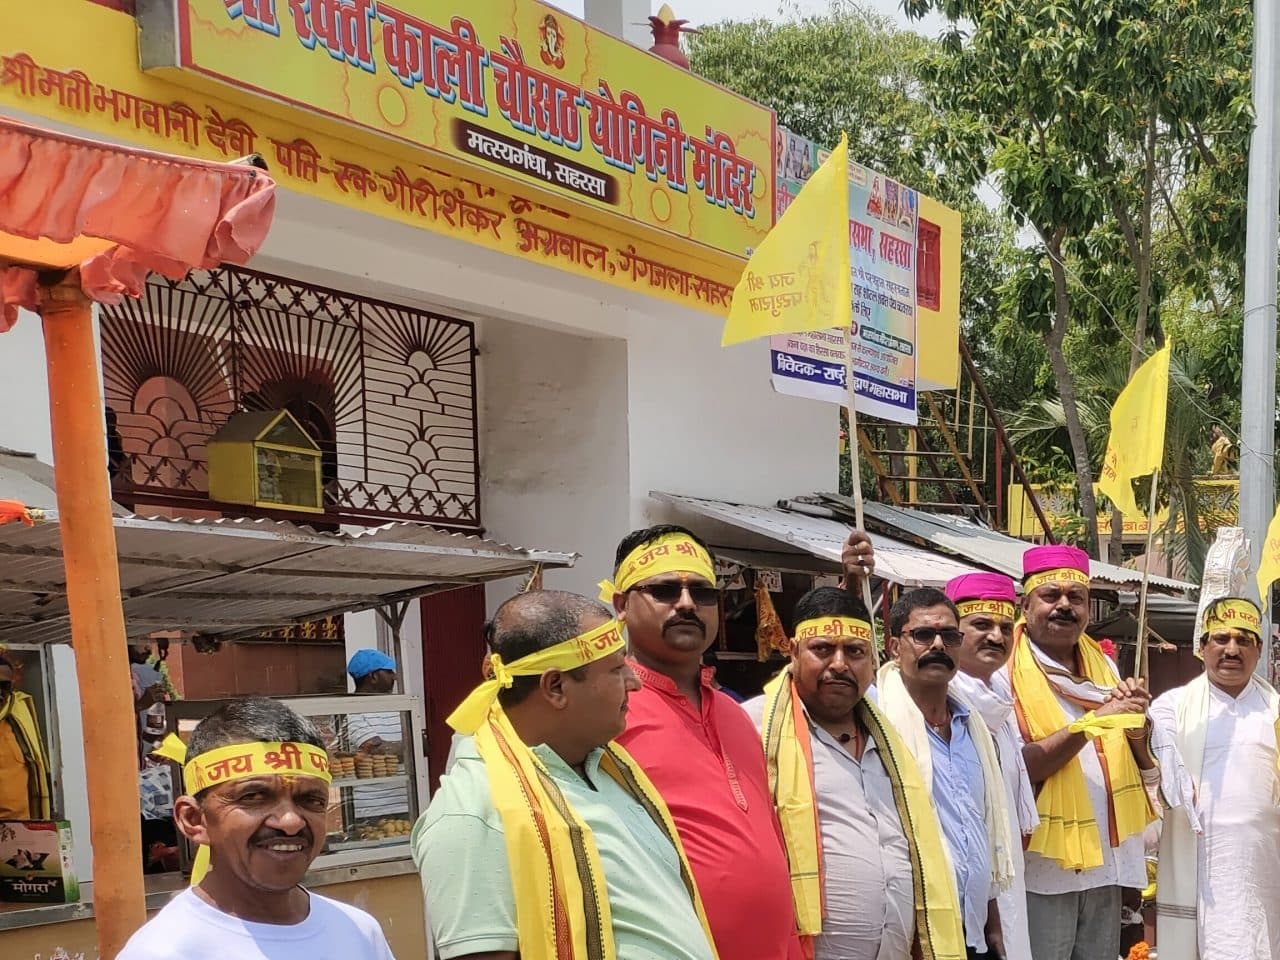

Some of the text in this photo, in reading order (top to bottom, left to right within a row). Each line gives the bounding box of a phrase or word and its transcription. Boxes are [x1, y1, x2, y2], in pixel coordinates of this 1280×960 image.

[376, 2, 489, 117] काली
[491, 36, 586, 151] चौसठ
[584, 78, 690, 194] योगिनी
[688, 125, 757, 219] मंदिर
[467, 128, 606, 198] मत्स्यगंधा, सहरसा
[879, 231, 913, 272] सहरसा
[690, 274, 734, 309] सहर
[637, 541, 698, 565] जय श्री
[1061, 569, 1077, 581] श्री
[963, 602, 985, 614] जय
[988, 601, 1004, 614] श्री
[590, 627, 620, 651] जय
[823, 619, 844, 636] श्री
[205, 753, 254, 781] जय
[264, 742, 302, 770] श्री
[13, 880, 49, 894] मोगरा
